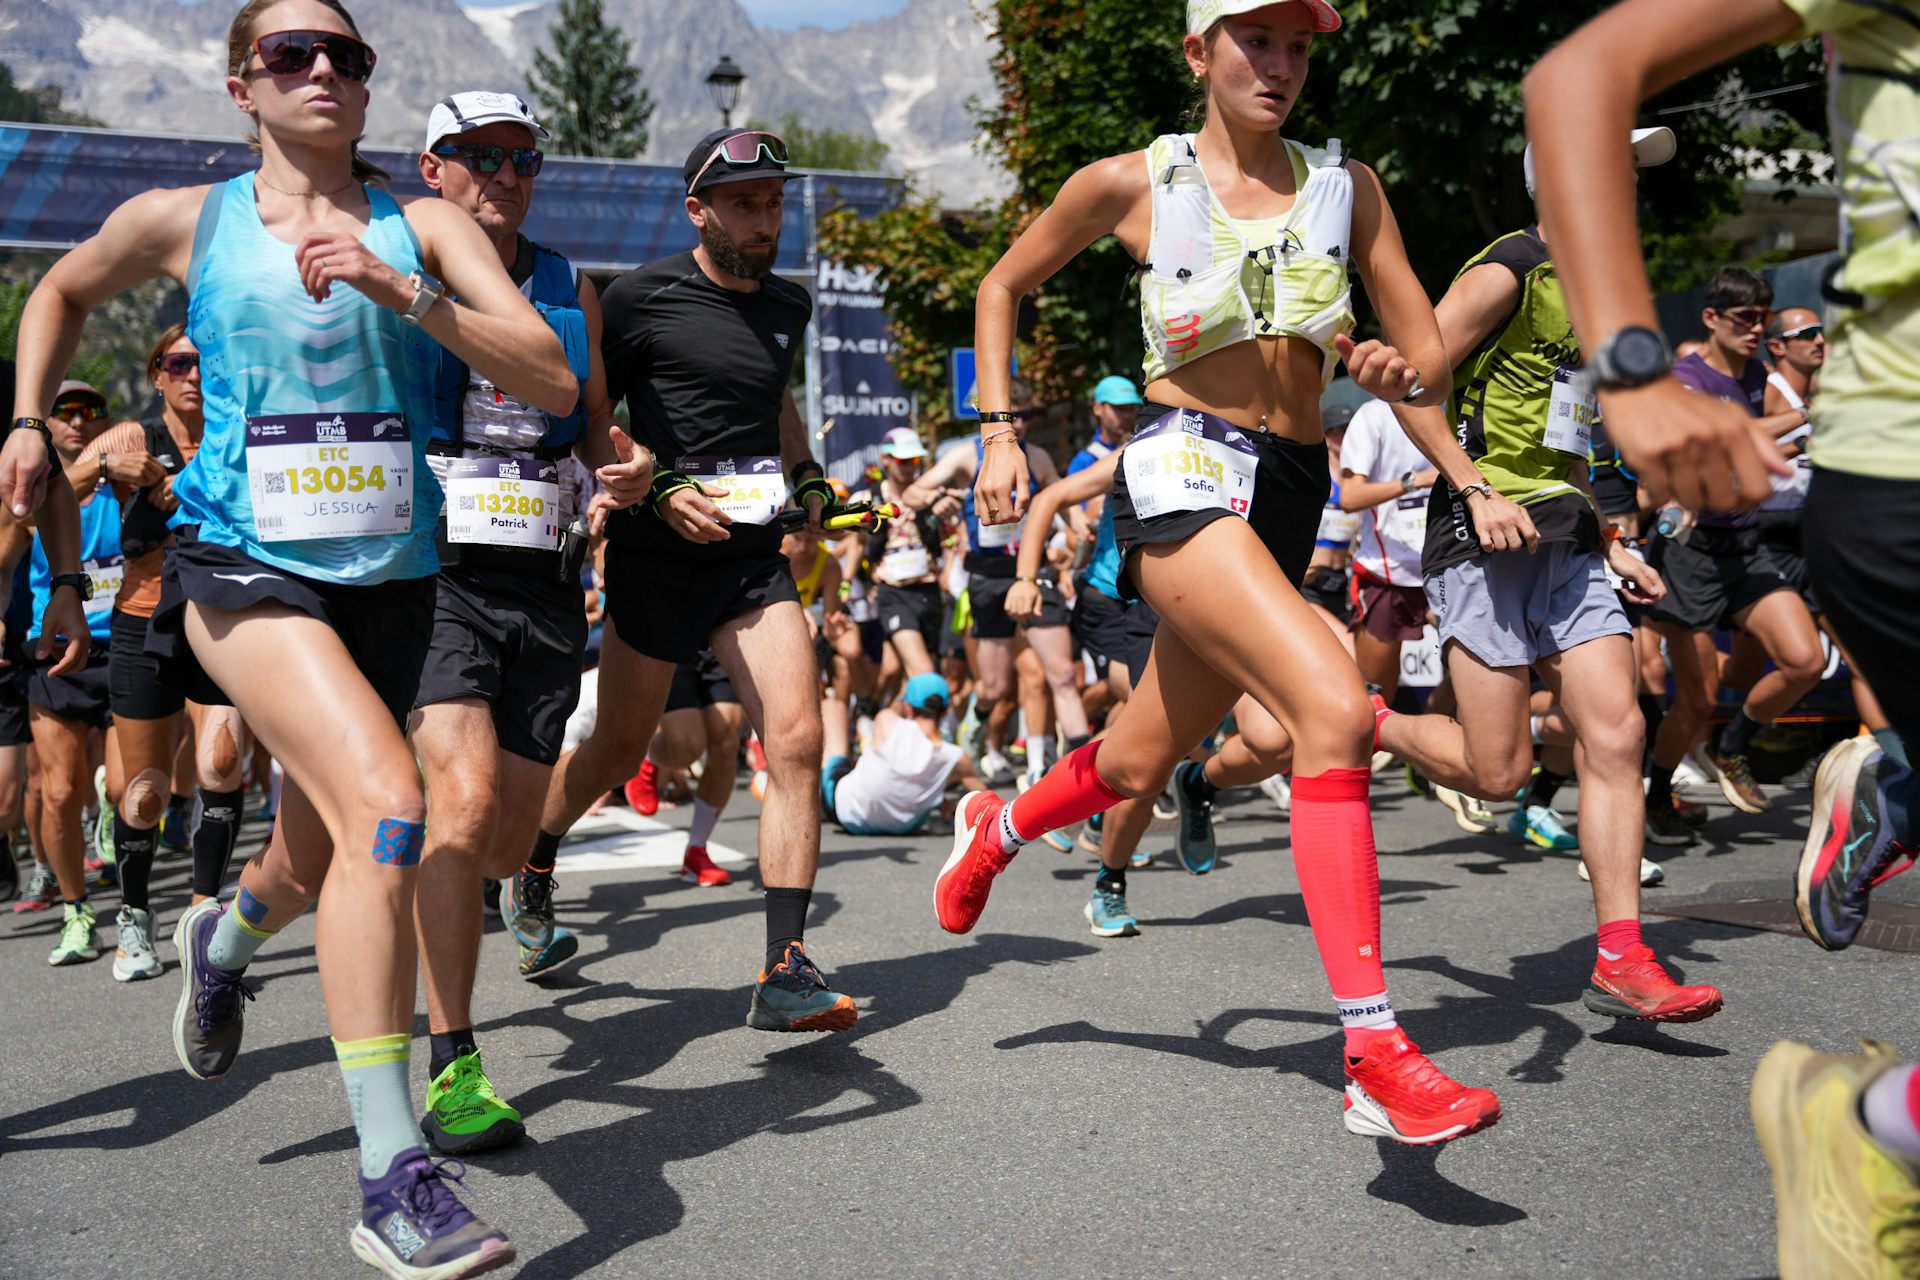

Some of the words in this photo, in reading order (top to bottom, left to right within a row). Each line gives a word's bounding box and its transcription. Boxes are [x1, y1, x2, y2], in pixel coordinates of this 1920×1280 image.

[823, 395, 910, 416] SUUNTO
[316, 426, 346, 436] UTMB
[1183, 418, 1204, 432] UTMB
[1185, 436, 1205, 451] ETC
[319, 447, 349, 461] ETC
[499, 466, 520, 475] UTMB
[286, 465, 387, 495] 13054
[397, 475, 402, 487] 1
[499, 481, 520, 493] ETC
[1184, 478, 1214, 492] Sofia
[1238, 477, 1243, 487] 1
[304, 501, 378, 516] JESSICA
[476, 493, 545, 517] 13280
[491, 517, 528, 529] Patrick
[1452, 501, 1468, 541] CLUB
